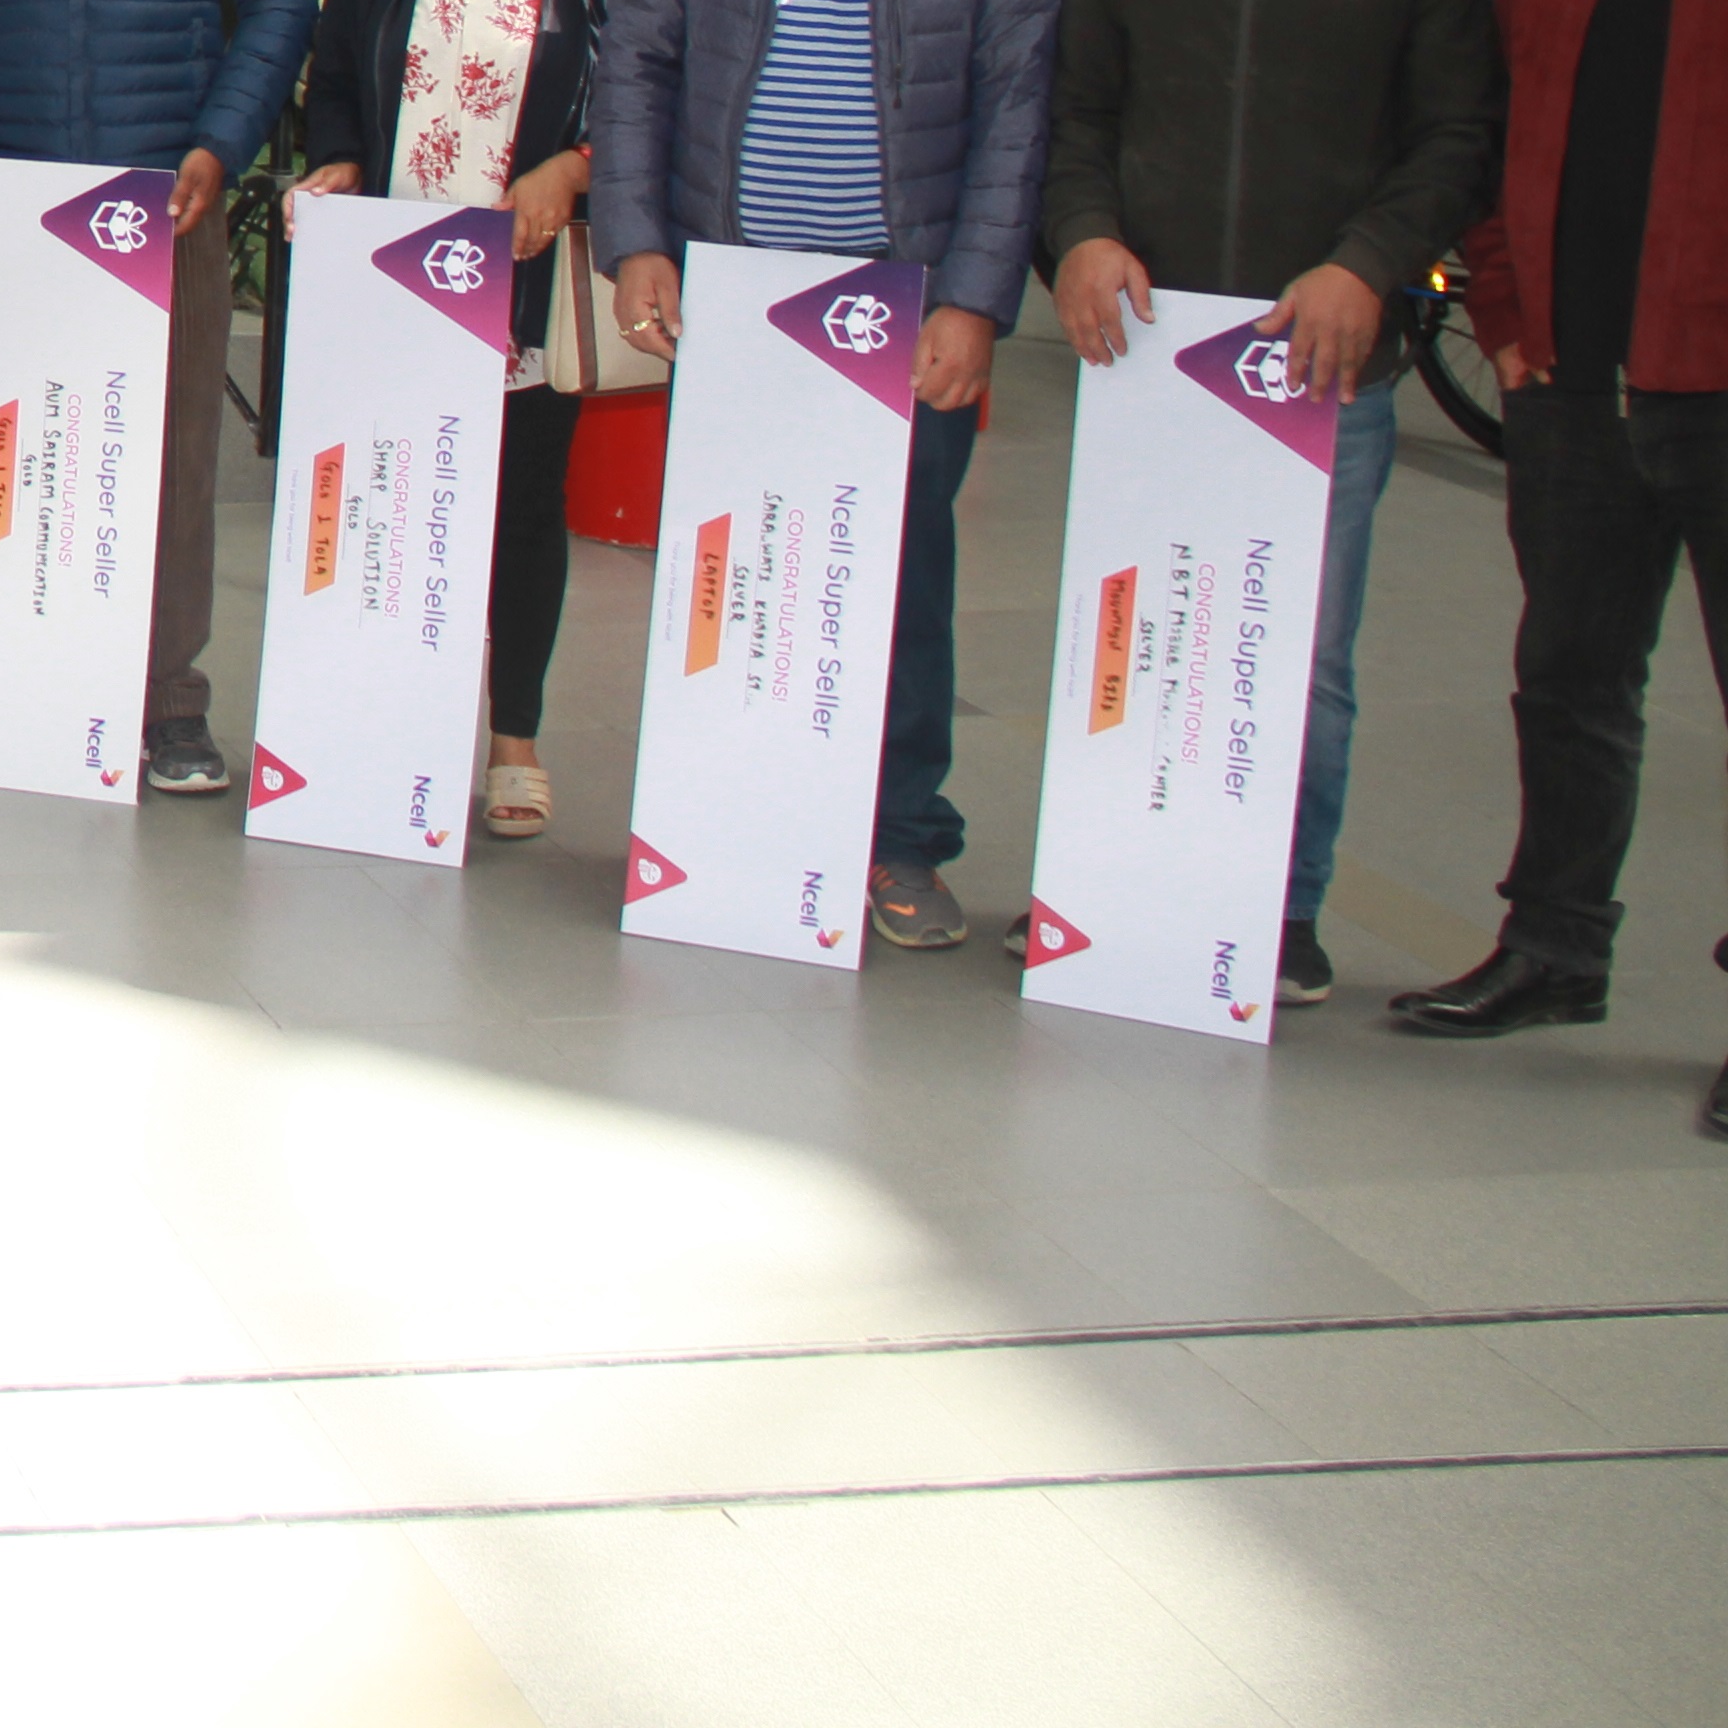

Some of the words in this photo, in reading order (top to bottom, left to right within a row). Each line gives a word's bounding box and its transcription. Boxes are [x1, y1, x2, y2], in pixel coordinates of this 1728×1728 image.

[45, 380, 64, 418] AUM
[104, 371, 126, 433] Ncell
[41, 430, 61, 499] SAIRAM
[58, 393, 82, 566] CONGRATULATIONS!
[96, 442, 122, 518] Super
[370, 440, 394, 492] SHARP
[435, 414, 460, 480] Ncell
[345, 495, 363, 529] GOLD
[385, 439, 412, 618] CONGRATULATIONS!
[426, 489, 455, 568] Super
[829, 484, 858, 554] Ncell
[94, 527, 117, 598] Seller
[313, 538, 330, 575] TOLA
[364, 518, 386, 610] SOLUTION
[699, 553, 719, 620] LAPTOP
[1242, 538, 1273, 612] Ncell
[421, 576, 448, 651] Seller
[728, 564, 749, 622] SILVER
[772, 509, 804, 702] CONGRATULATIONS!
[818, 564, 850, 648] Super
[813, 658, 842, 739] Seller
[1181, 563, 1216, 765] CONGRATULATIONS!
[1231, 622, 1265, 710] Super
[85, 717, 106, 769] Ncell
[1225, 719, 1256, 803] Seller
[409, 774, 433, 829] Ncell
[800, 870, 824, 928] Ncell
[1211, 938, 1238, 1000] Ncell
